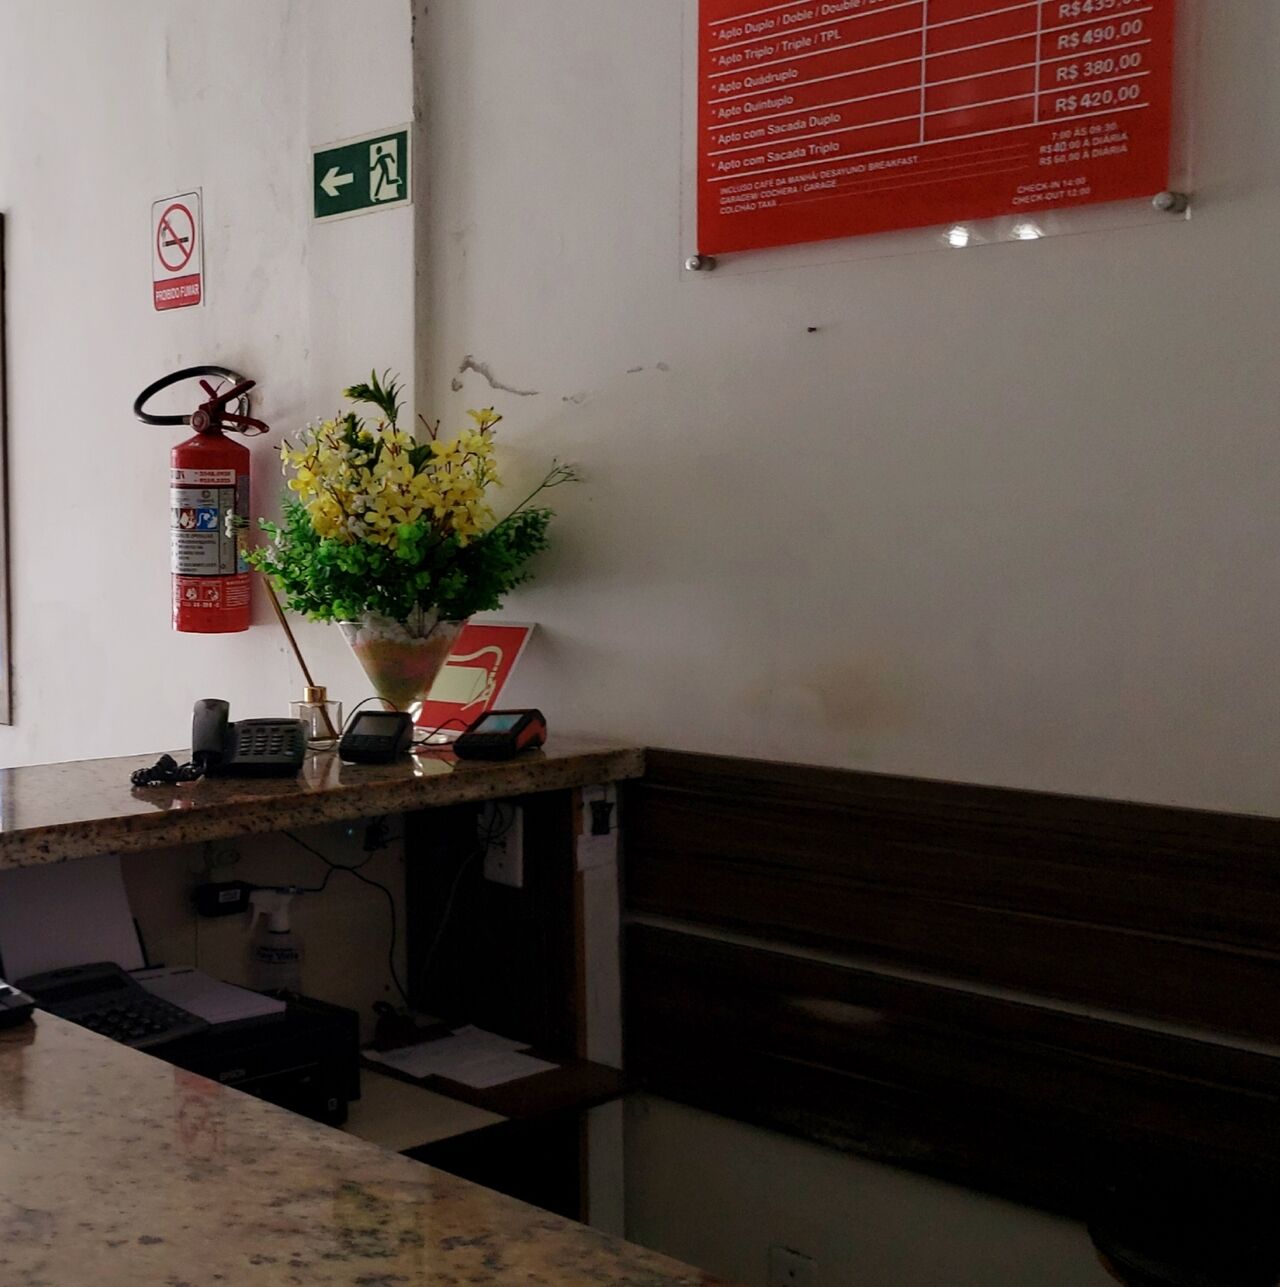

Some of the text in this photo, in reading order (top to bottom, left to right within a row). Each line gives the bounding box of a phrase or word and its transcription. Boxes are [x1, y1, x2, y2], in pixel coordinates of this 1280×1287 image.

[718, 27, 742, 40] Apto
[744, 19, 775, 34] Duplo
[718, 53, 742, 66] Apto
[744, 45, 774, 60] Triplo
[781, 37, 812, 51] Triple
[820, 29, 842, 42] TPL
[718, 81, 742, 94] Apto
[718, 106, 742, 119] Apto
[718, 112, 841, 144] Apto com Sacada Duplo
[718, 142, 840, 172] Apto com Sacada Triplo
[156, 283, 199, 301] PROIBIDO FUMAR
